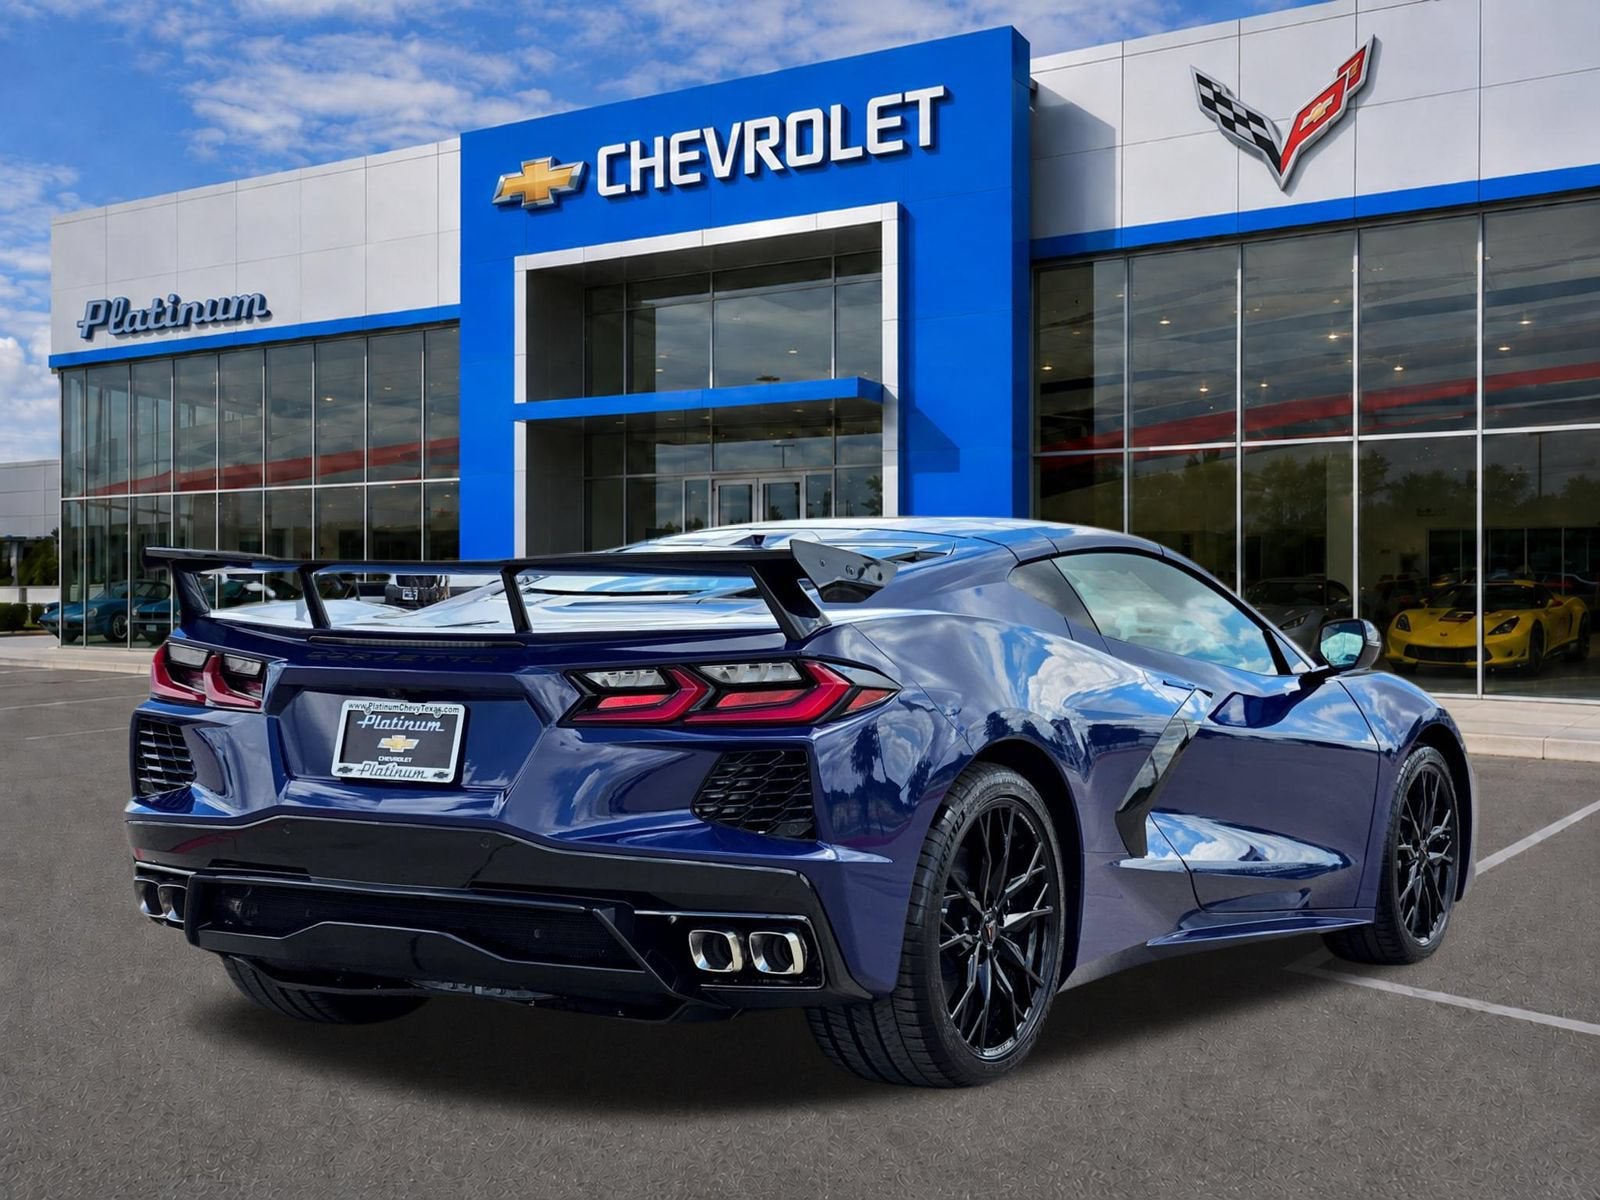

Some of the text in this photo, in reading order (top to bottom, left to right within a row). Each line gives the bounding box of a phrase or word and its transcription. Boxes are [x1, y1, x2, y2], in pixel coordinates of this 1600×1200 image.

[596, 85, 945, 197] CHEVROLET
[77, 291, 271, 339] Platinum
[348, 702, 460, 715] www.PlatinumChevyTexas.com
[357, 714, 445, 732] Platinum
[378, 755, 413, 763] CHEVROLET
[357, 763, 428, 779] Platinum
